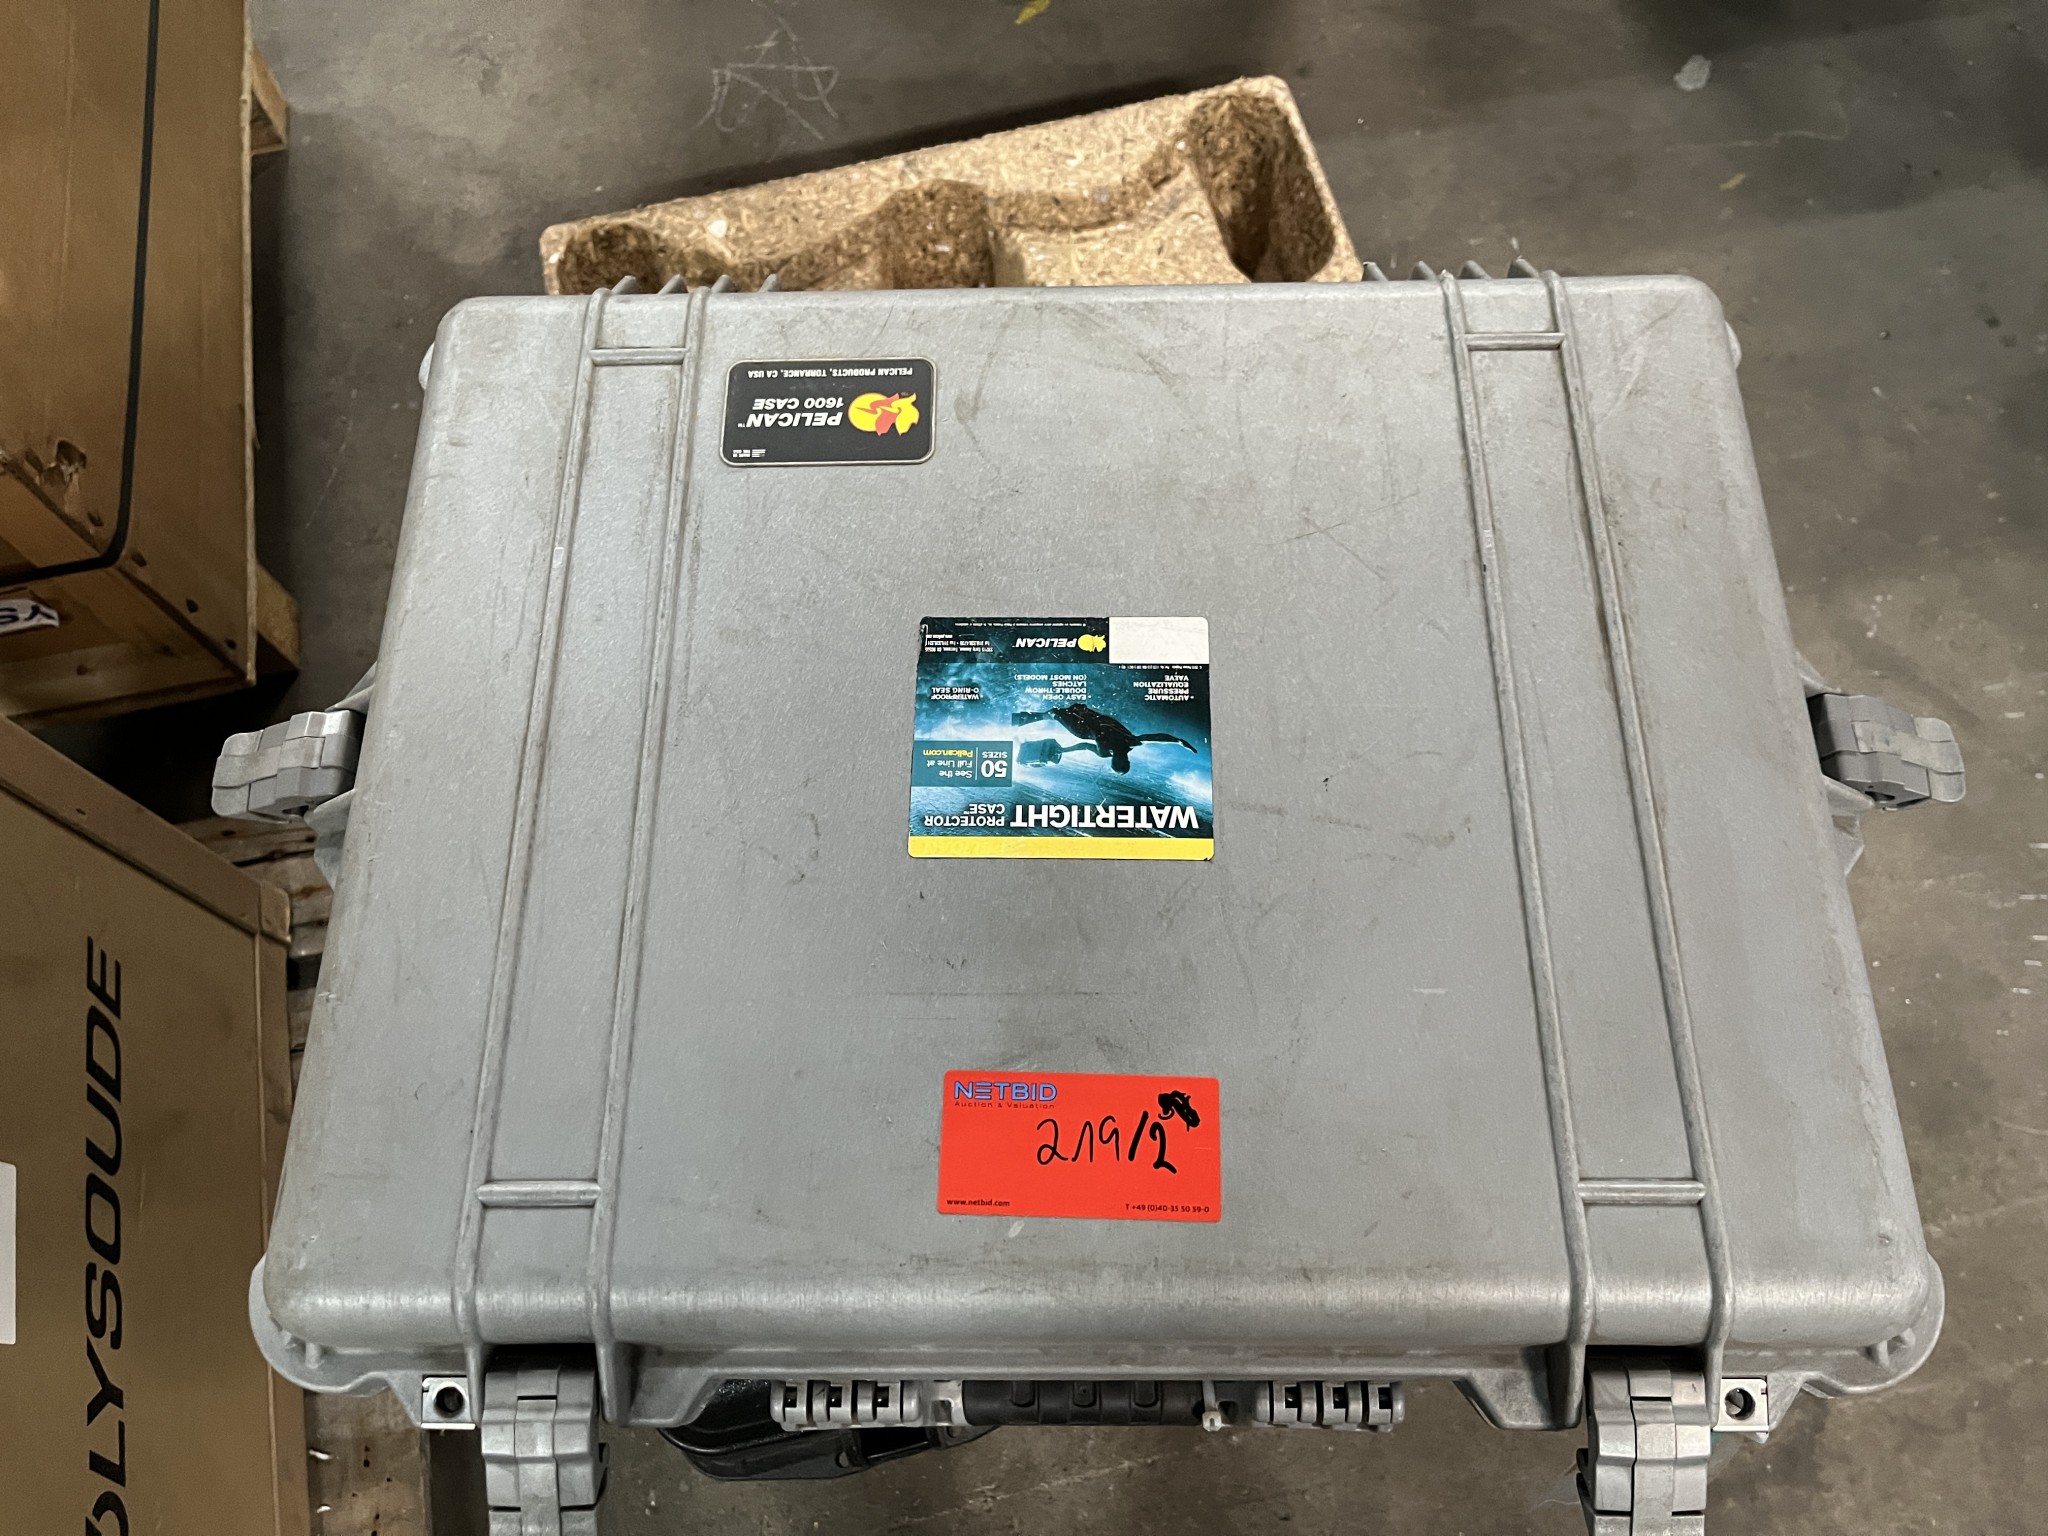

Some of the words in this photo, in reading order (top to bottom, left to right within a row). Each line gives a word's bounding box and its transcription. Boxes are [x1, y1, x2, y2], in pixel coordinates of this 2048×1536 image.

[748, 370, 765, 378] USA
[767, 370, 778, 378] CA
[780, 369, 827, 379] TORRANCE,
[829, 368, 876, 378] PRODUCTS,
[877, 367, 913, 376] PELICAN
[753, 398, 799, 410] CASE
[804, 397, 844, 409] 1600
[931, 686, 952, 694] SEAL
[953, 686, 980, 694] O-RING
[1148, 687, 1190, 695] PRESSURE
[931, 692, 980, 700] WATERPROOF
[1042, 693, 1063, 701] OPEN
[1064, 693, 1087, 701] EASY
[922, 749, 973, 758] Pelican.com
[982, 751, 1008, 759] SIZES
[926, 760, 936, 768] at
[937, 760, 956, 768] Line
[957, 760, 973, 768] Full
[981, 760, 1008, 778] 50
[938, 770, 953, 779] the
[954, 770, 973, 779] See
[1010, 804, 1200, 829] WATERTIGHT
[924, 815, 1005, 827] PROTECTOR
[953, 1081, 1058, 1102] NETBID
[946, 1198, 1011, 1207] www.netbid.com
[1191, 1205, 1210, 1213] 59-0
